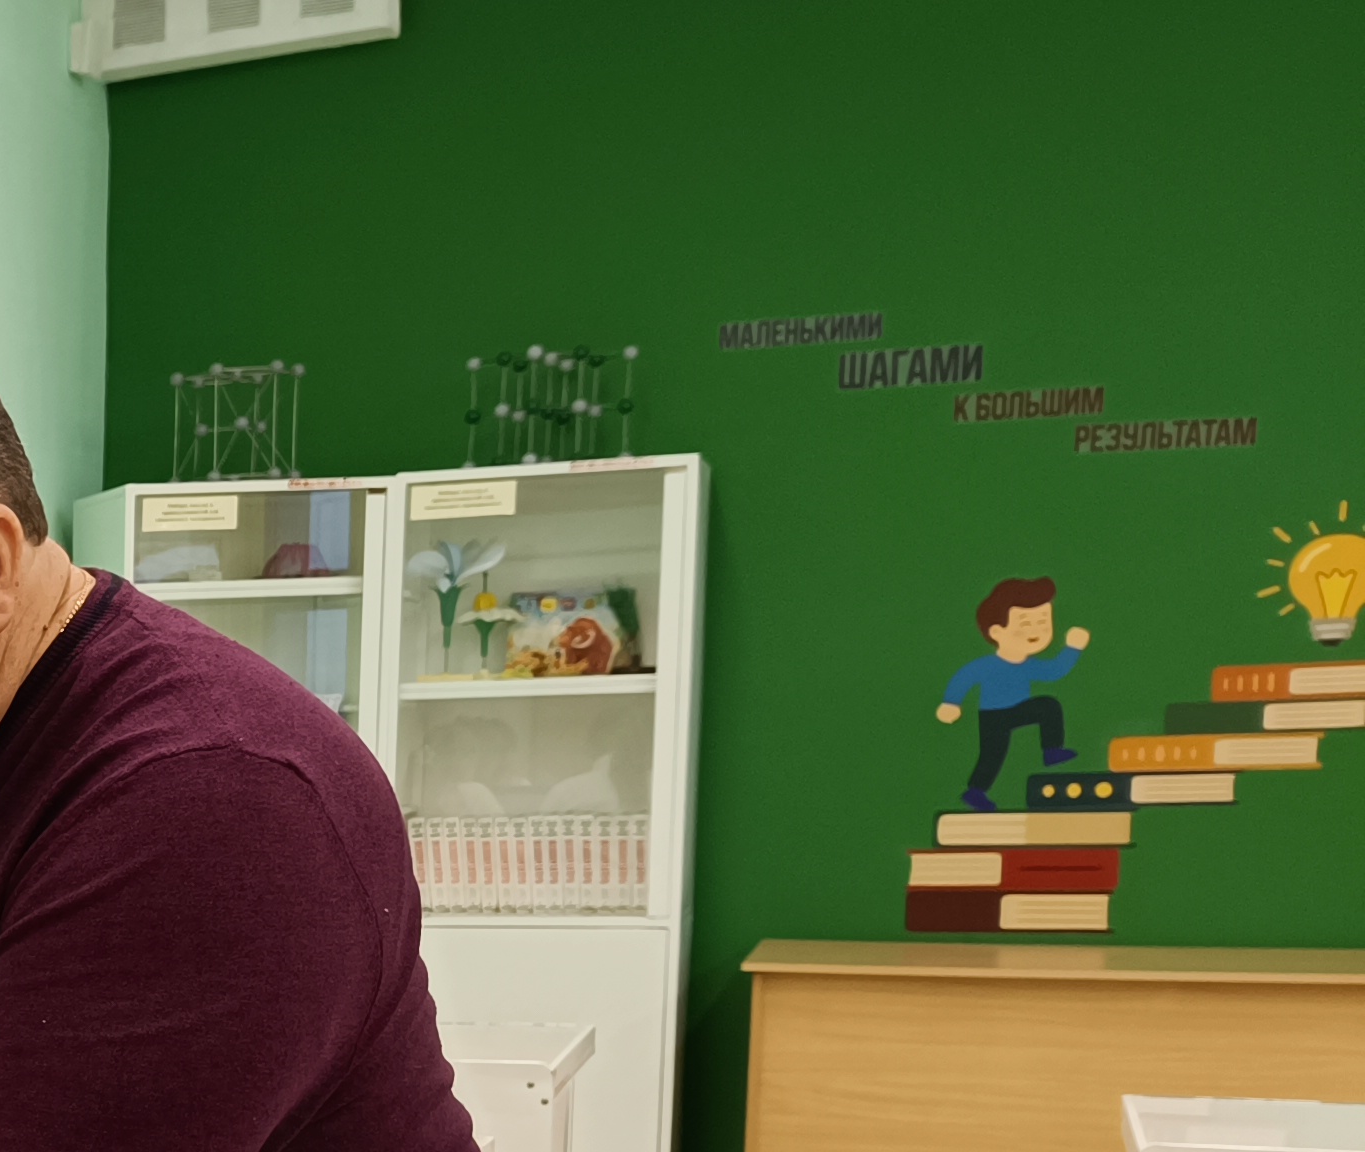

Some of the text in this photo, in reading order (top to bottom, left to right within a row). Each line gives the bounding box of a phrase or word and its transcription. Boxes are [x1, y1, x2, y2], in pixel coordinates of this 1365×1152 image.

[718, 311, 883, 350] МАЛЕНЬКИМИ
[837, 344, 985, 390] ШАГАМИ
[953, 386, 1106, 422] К БОЛЬШИМ
[1073, 416, 1259, 453] РЕЗУЛЬТАТАМ
